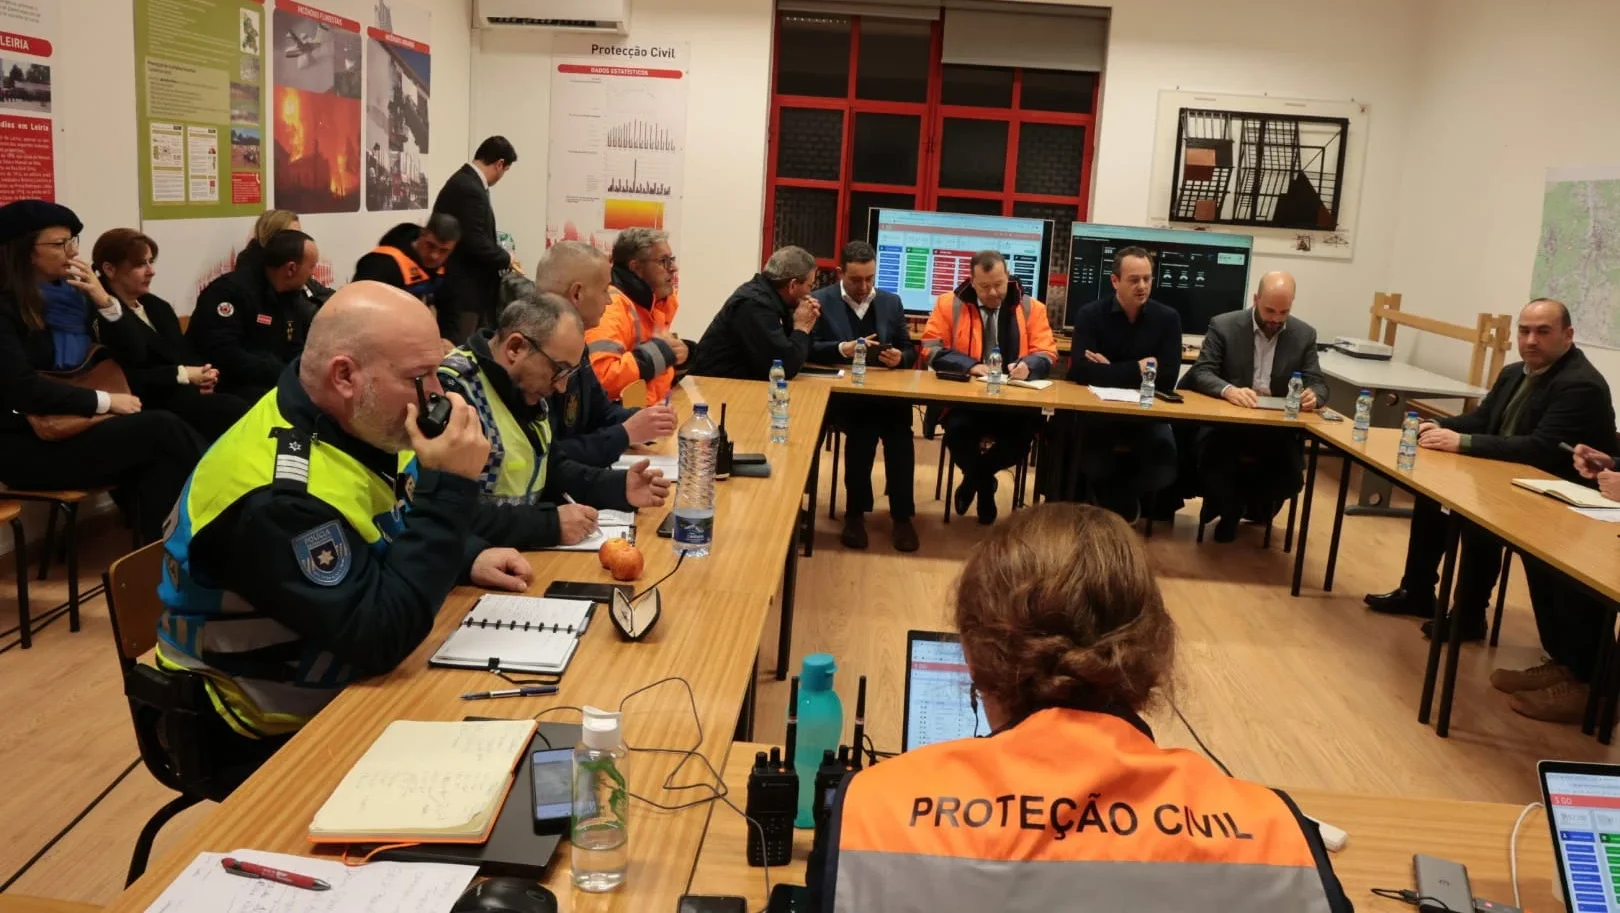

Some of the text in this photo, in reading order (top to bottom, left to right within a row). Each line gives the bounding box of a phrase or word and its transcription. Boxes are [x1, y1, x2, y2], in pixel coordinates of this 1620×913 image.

[0, 35, 29, 50] LEIRIA
[591, 44, 676, 59] Protecção Civil
[30, 122, 49, 131] Leiria
[909, 793, 1254, 840] PROTEÇÃO CIVIL
